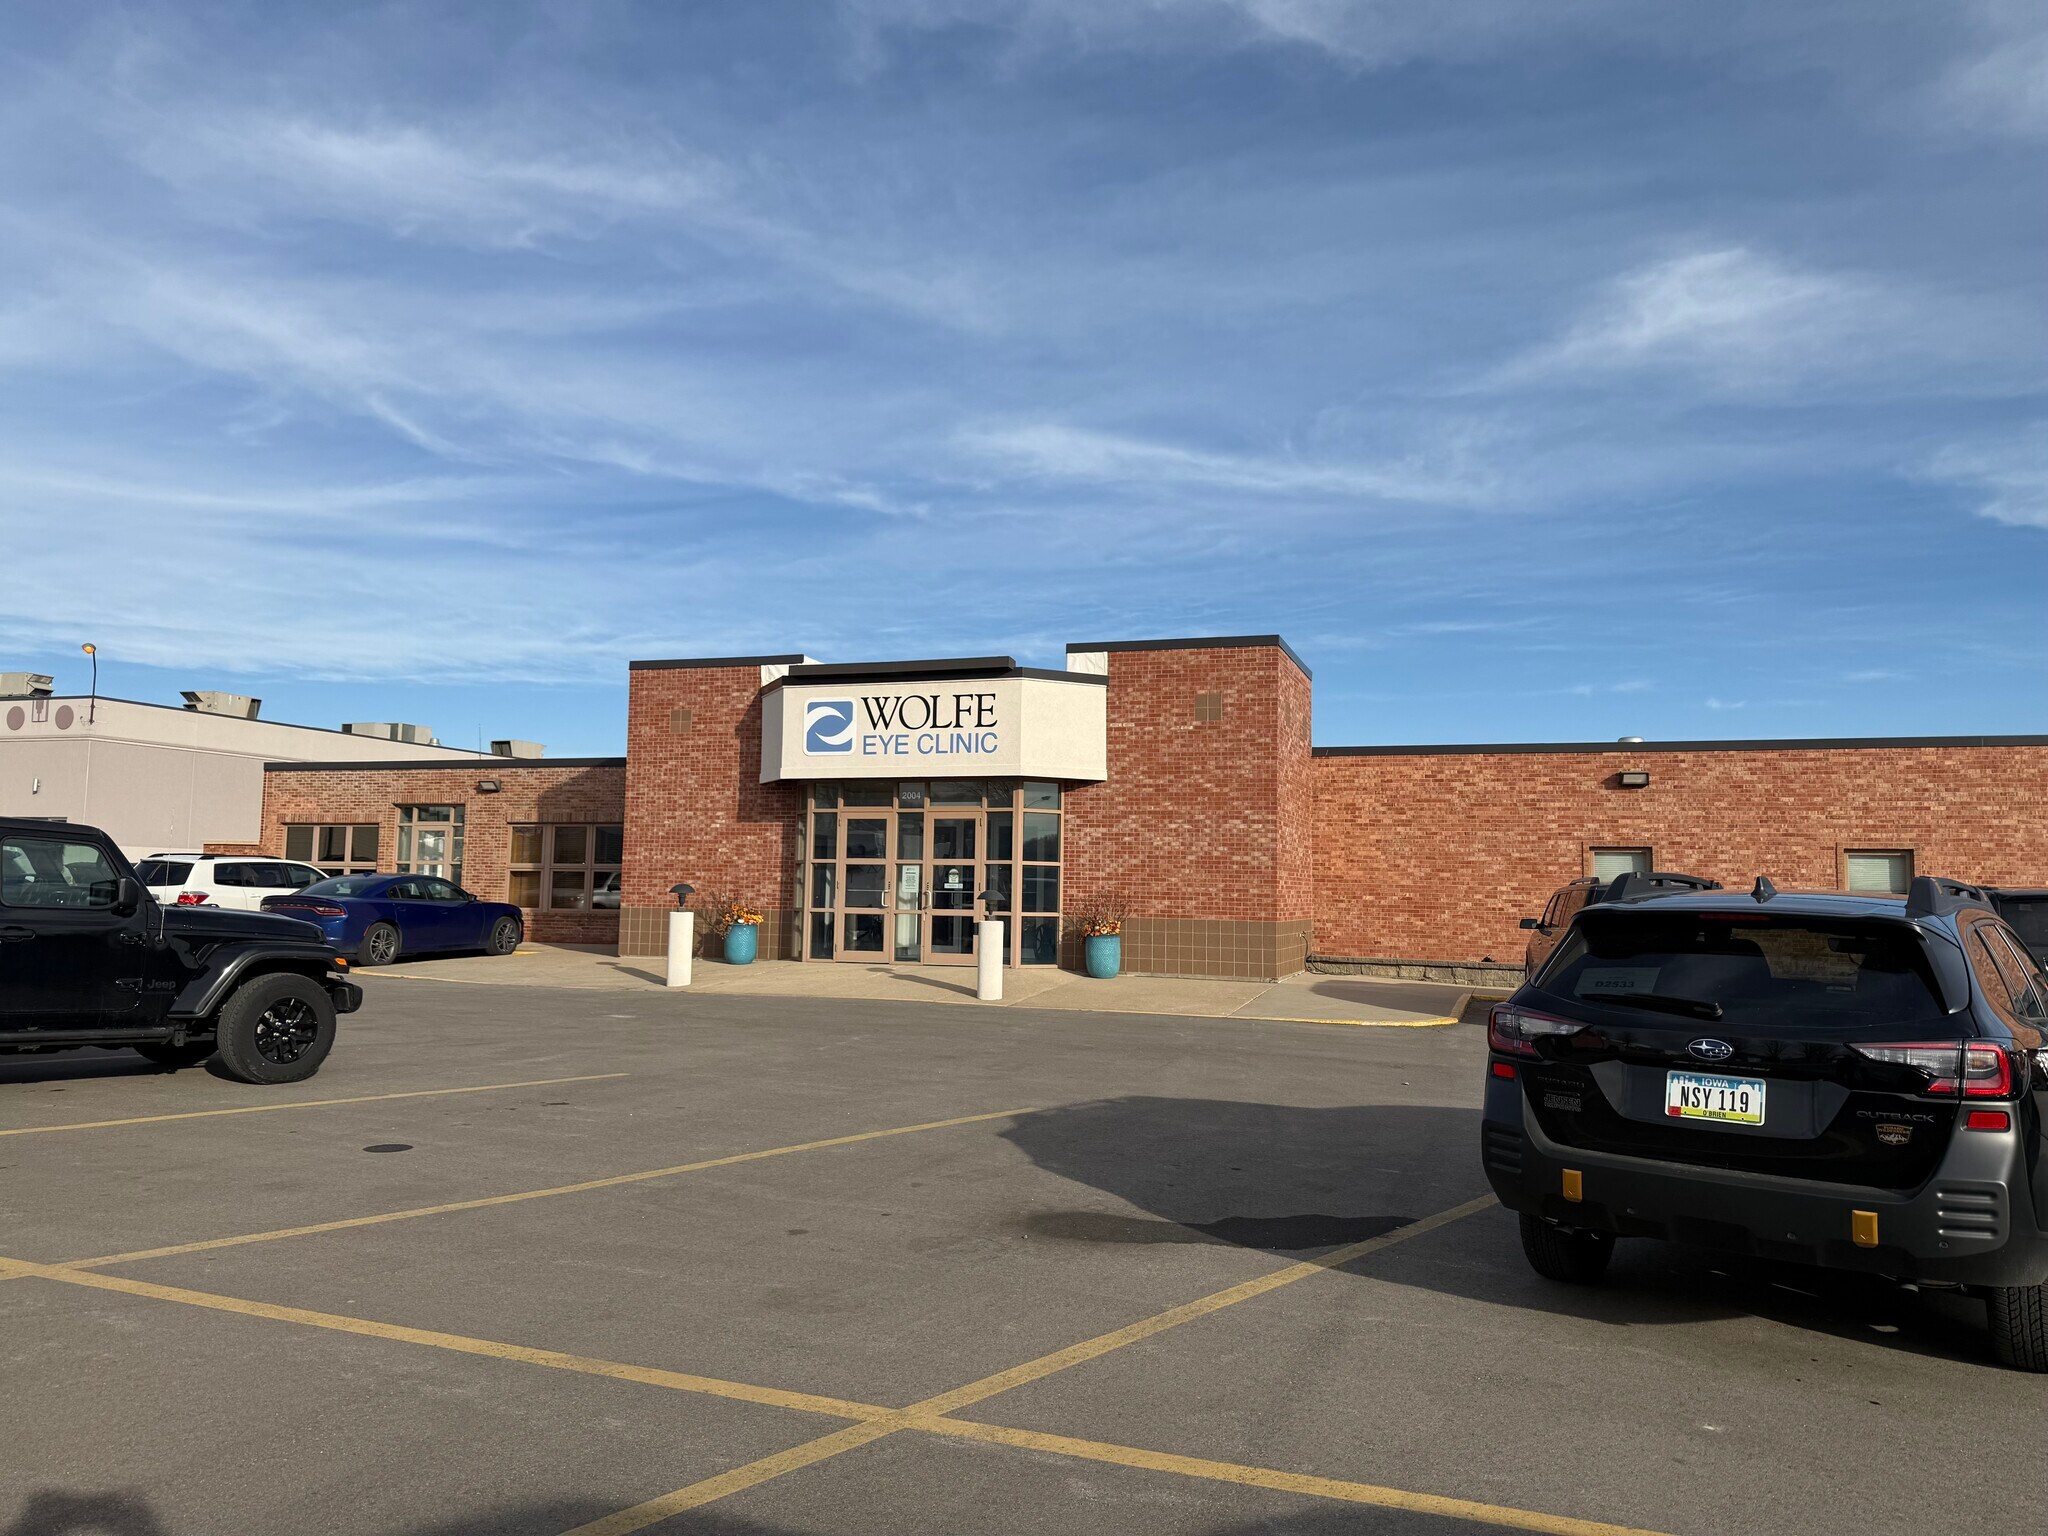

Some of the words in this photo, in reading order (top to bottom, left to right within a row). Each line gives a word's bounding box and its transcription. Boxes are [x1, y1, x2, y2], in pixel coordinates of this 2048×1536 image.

[861, 693, 998, 730] WOLFE
[863, 734, 909, 755] EYE
[917, 732, 998, 754] CLINIC
[902, 791, 921, 800] 2004
[146, 978, 176, 990] Jeep
[1701, 1078, 1729, 1088] IOWA
[1680, 1086, 1712, 1109] NSY
[1718, 1090, 1749, 1113] 119
[1702, 1110, 1727, 1118] O'BRIEN
[1856, 1111, 1934, 1122] OUTBACK
